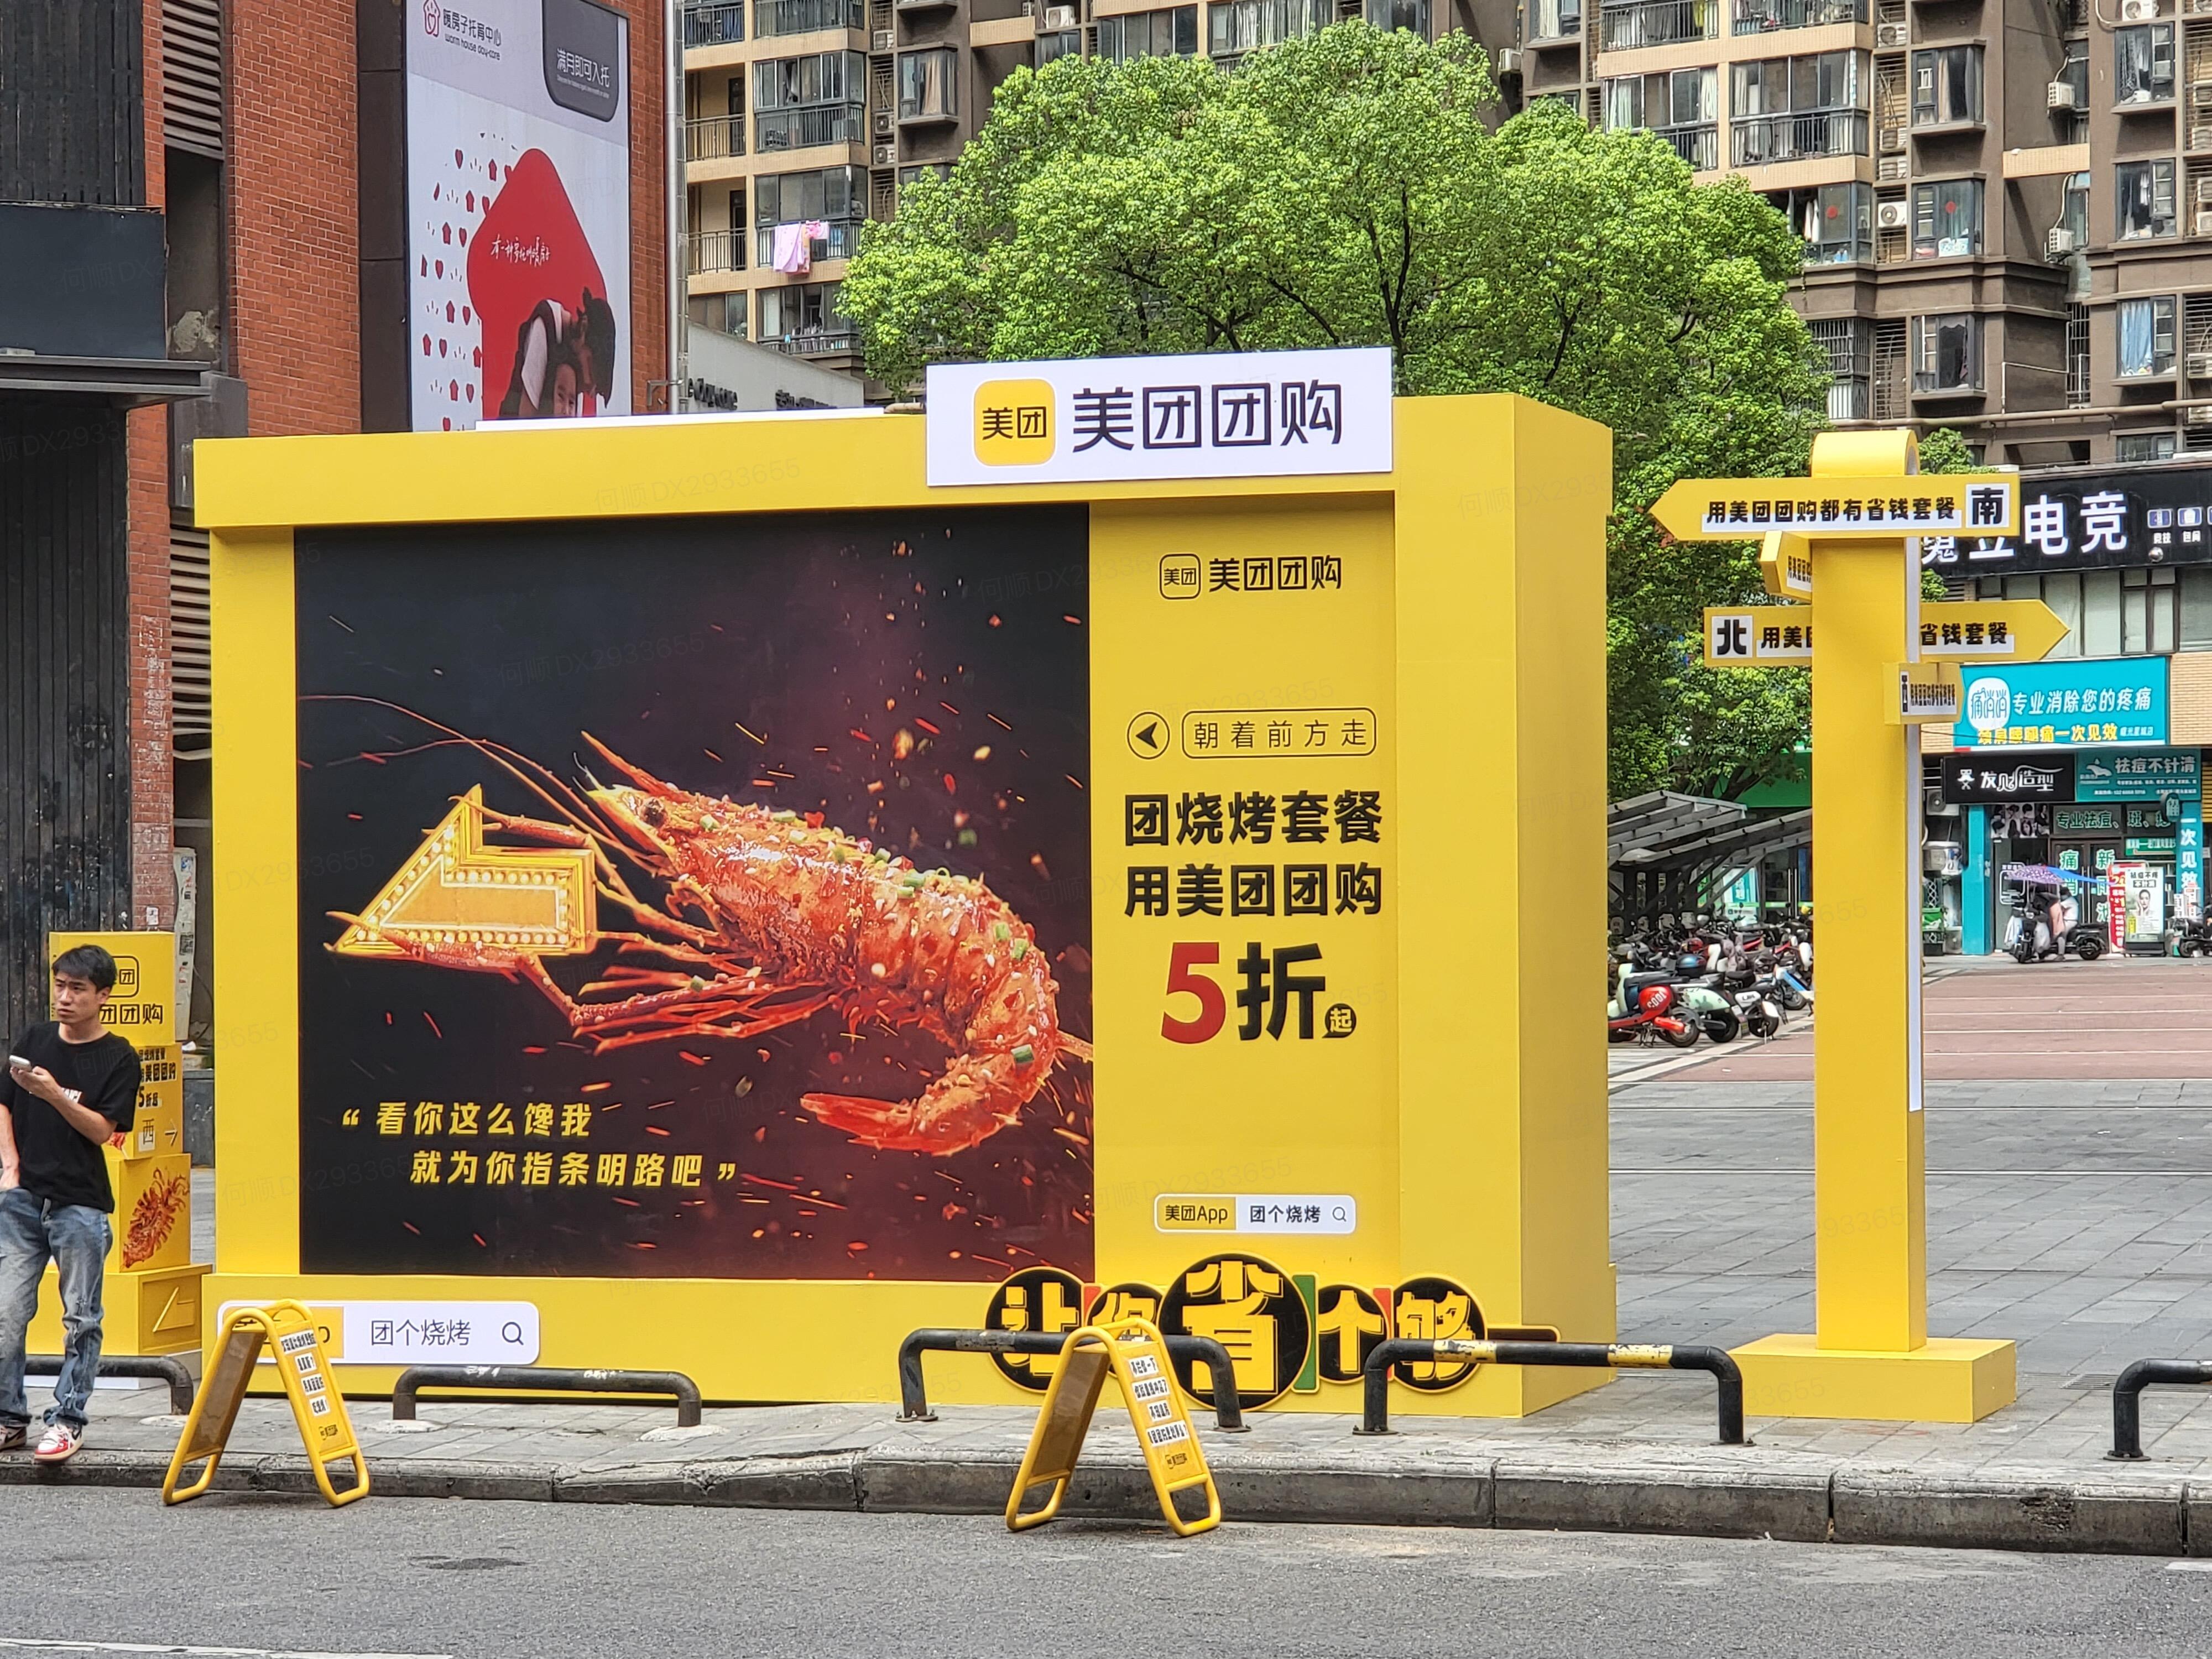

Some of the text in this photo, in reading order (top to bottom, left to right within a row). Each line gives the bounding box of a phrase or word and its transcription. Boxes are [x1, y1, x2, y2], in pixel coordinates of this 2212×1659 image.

[557, 48, 609, 88] 满月即可入托
[982, 406, 1047, 441] 美团
[1072, 378, 1341, 453] 美团团购
[1706, 488, 2004, 525] 用美团团购都有省钱套餐 南
[1164, 567, 1197, 587] 美团
[1209, 555, 1342, 592] 美团团购
[1717, 619, 1812, 655] 北 用美
[1921, 622, 2007, 646] 省钱套餐
[2012, 686, 2152, 716] 专业消除您的疼痛
[1193, 718, 1367, 750] 朝着前方走
[1124, 790, 1383, 847] 团烧烤套餐
[1124, 862, 1382, 917] 用美团团购
[113, 968, 135, 985] 团
[142, 1118, 155, 1145] 西
[1165, 1204, 1228, 1224] 美团App
[1250, 1205, 1321, 1223] 团个烧烤
[371, 1318, 472, 1347] 团个烧烤
